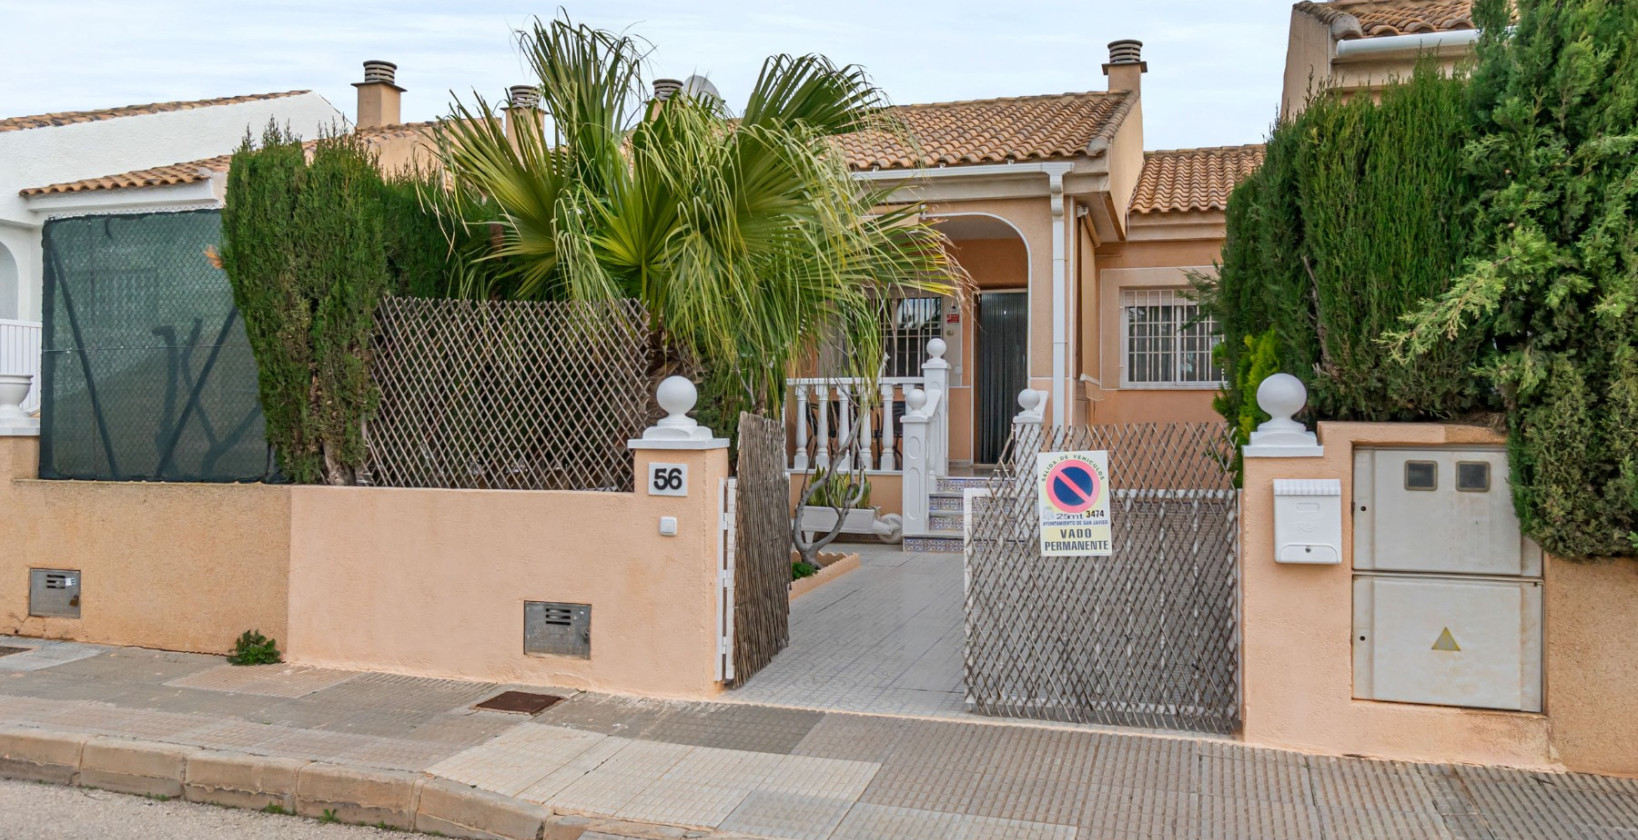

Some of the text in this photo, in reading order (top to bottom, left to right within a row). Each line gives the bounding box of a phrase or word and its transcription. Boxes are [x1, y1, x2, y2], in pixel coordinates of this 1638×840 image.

[1041, 460, 1058, 482] SALIDA
[653, 467, 683, 491] 56
[1085, 510, 1105, 518] 3474
[1060, 528, 1092, 539] VADO
[1044, 540, 1109, 551] PERMANENTE
